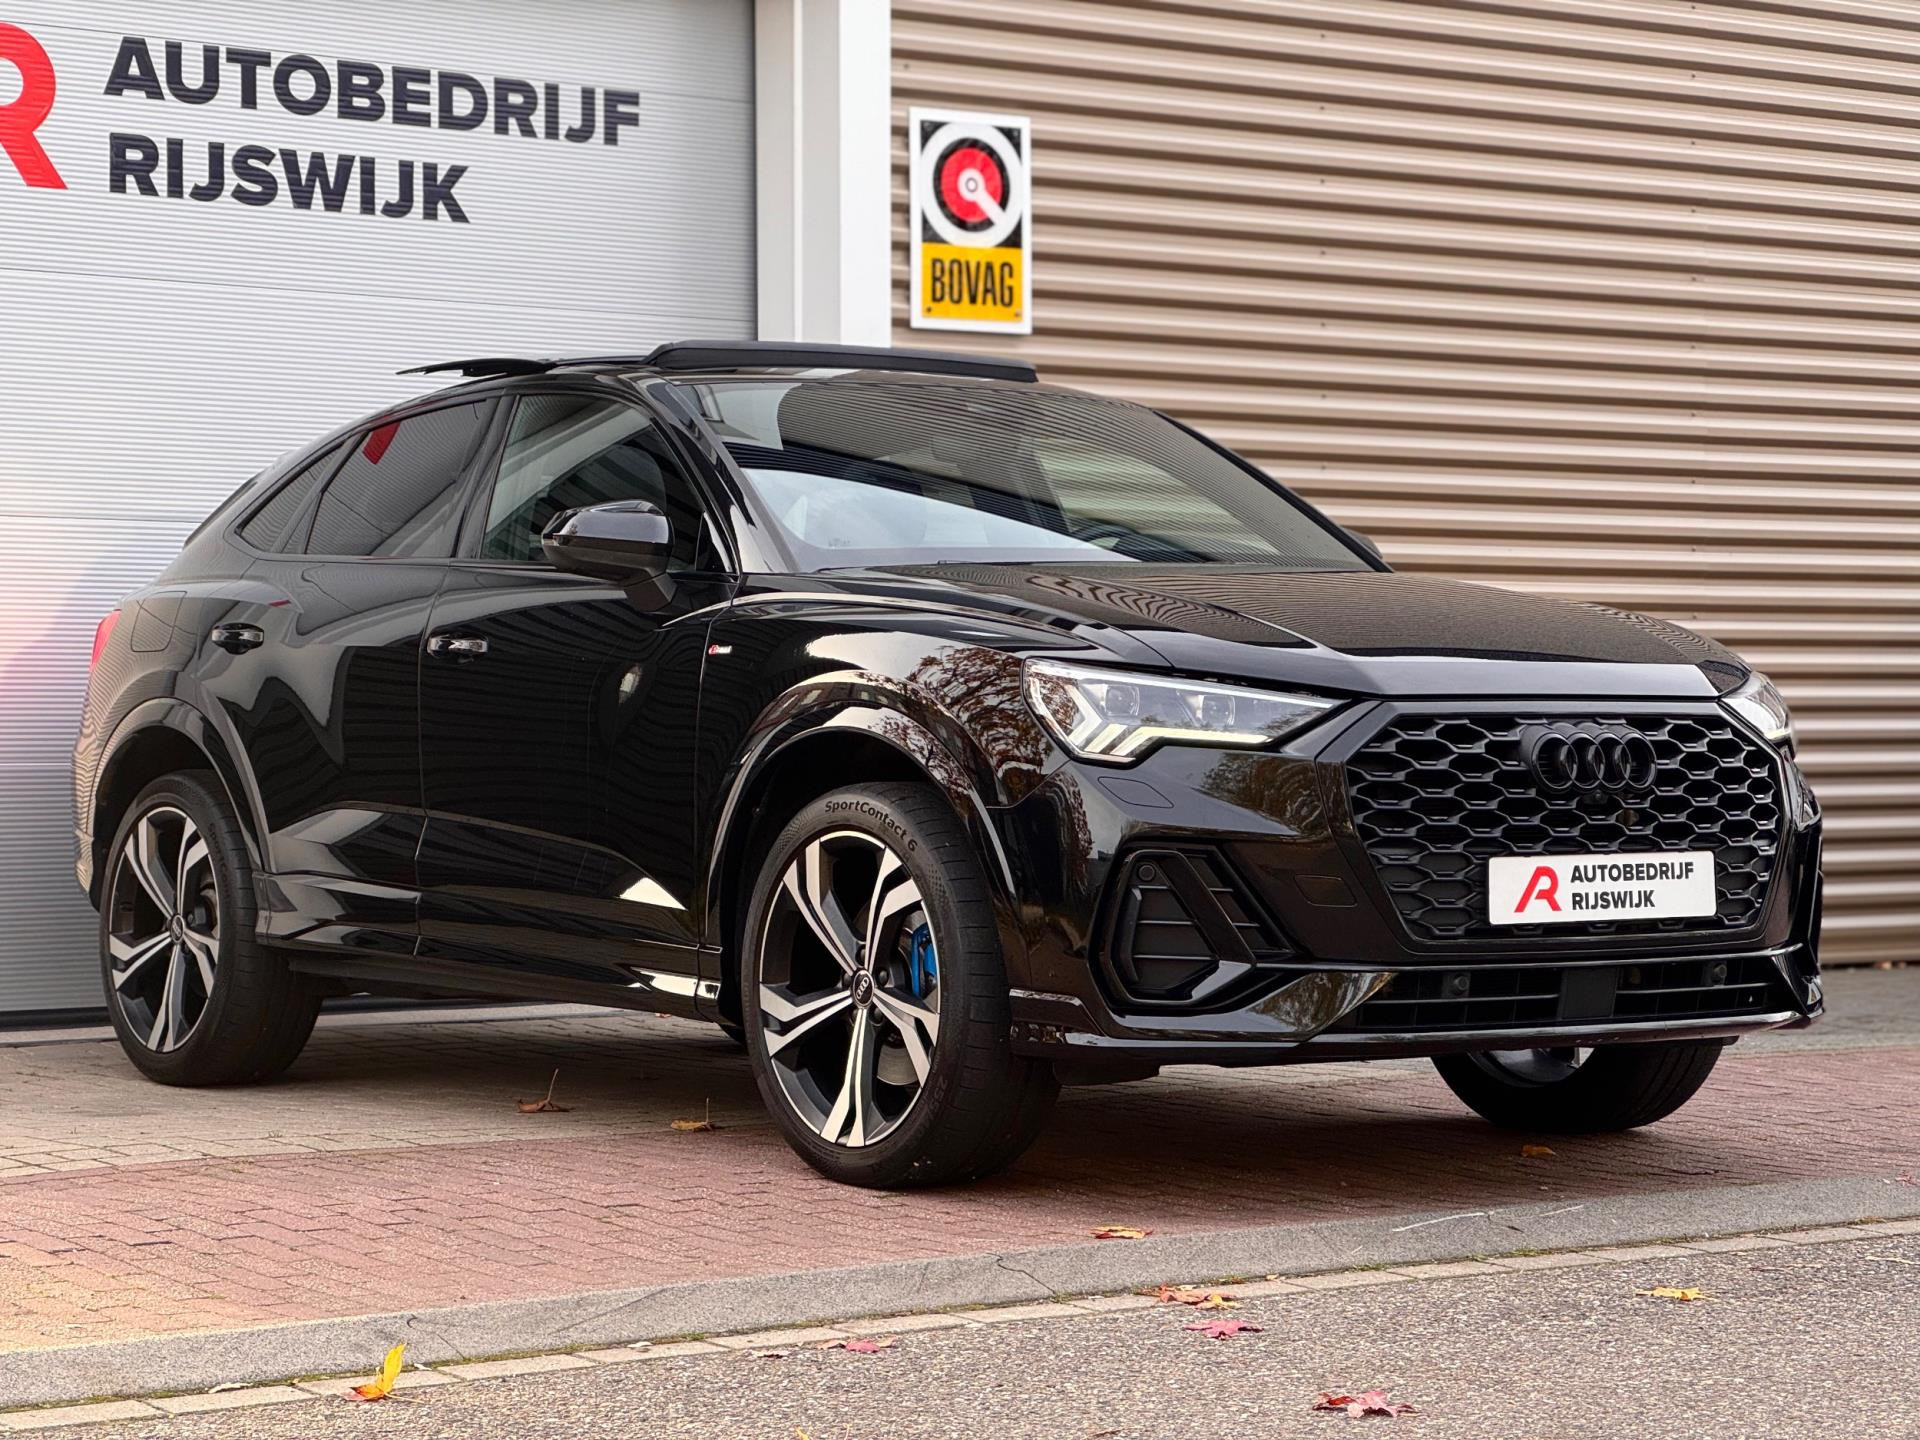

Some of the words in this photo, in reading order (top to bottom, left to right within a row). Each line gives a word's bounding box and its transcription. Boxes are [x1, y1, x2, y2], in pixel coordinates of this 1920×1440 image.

[103, 36, 641, 146] AUTOBEDRIJF
[108, 131, 471, 224] RIJSWIJK
[930, 257, 1014, 308] BOVAG
[824, 800, 908, 840] SportContact
[907, 839, 918, 852] 6
[1570, 861, 1694, 883] AUTOBEDRIJF
[1571, 889, 1655, 911] RIJSWIJK
